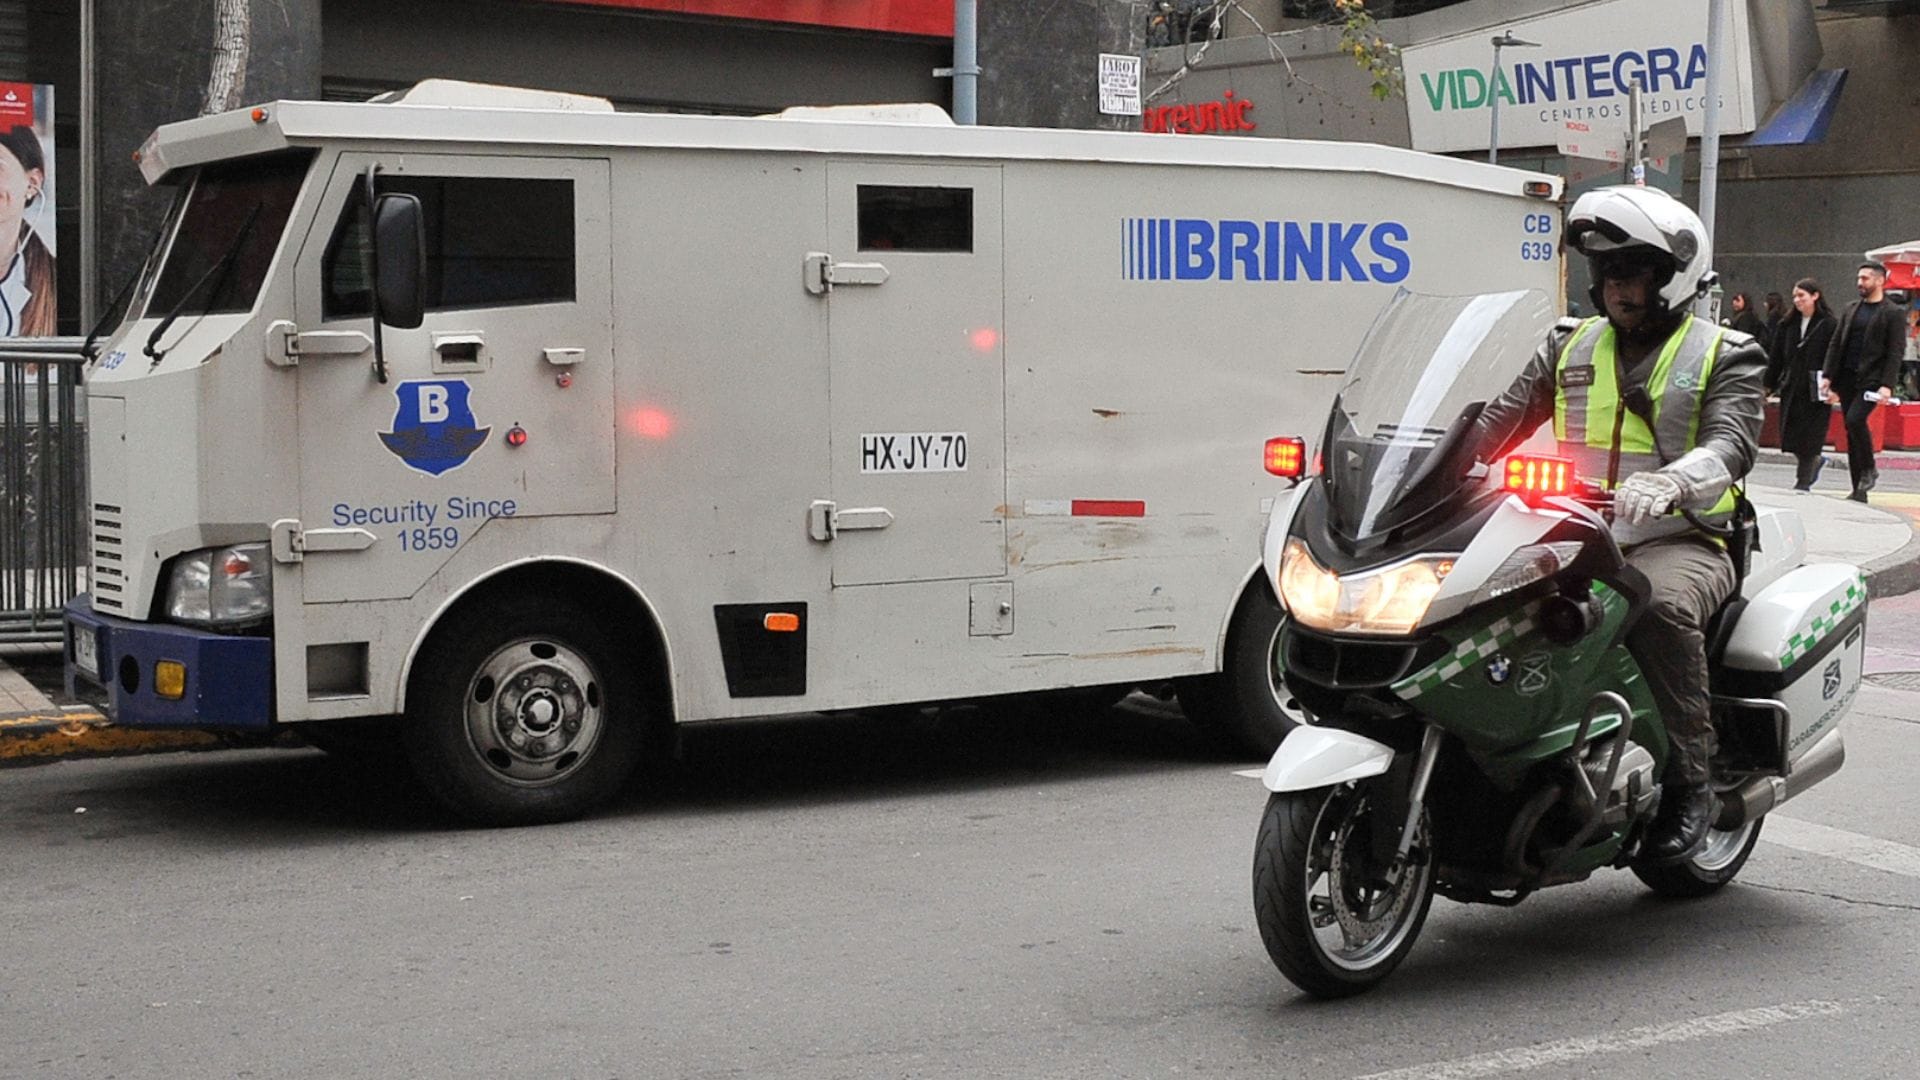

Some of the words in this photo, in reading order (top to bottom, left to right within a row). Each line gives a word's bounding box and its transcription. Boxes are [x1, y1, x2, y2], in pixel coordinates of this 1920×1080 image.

[1420, 44, 1707, 112] VIDAINTEGRA
[1540, 104, 1622, 122] CENTROS
[1524, 214, 1551, 233] CB
[1175, 219, 1410, 284] BRINKS
[1521, 241, 1553, 261] 639
[418, 385, 449, 423] B
[333, 500, 438, 527] Security
[447, 496, 517, 519] Since
[397, 526, 459, 552] 1859
